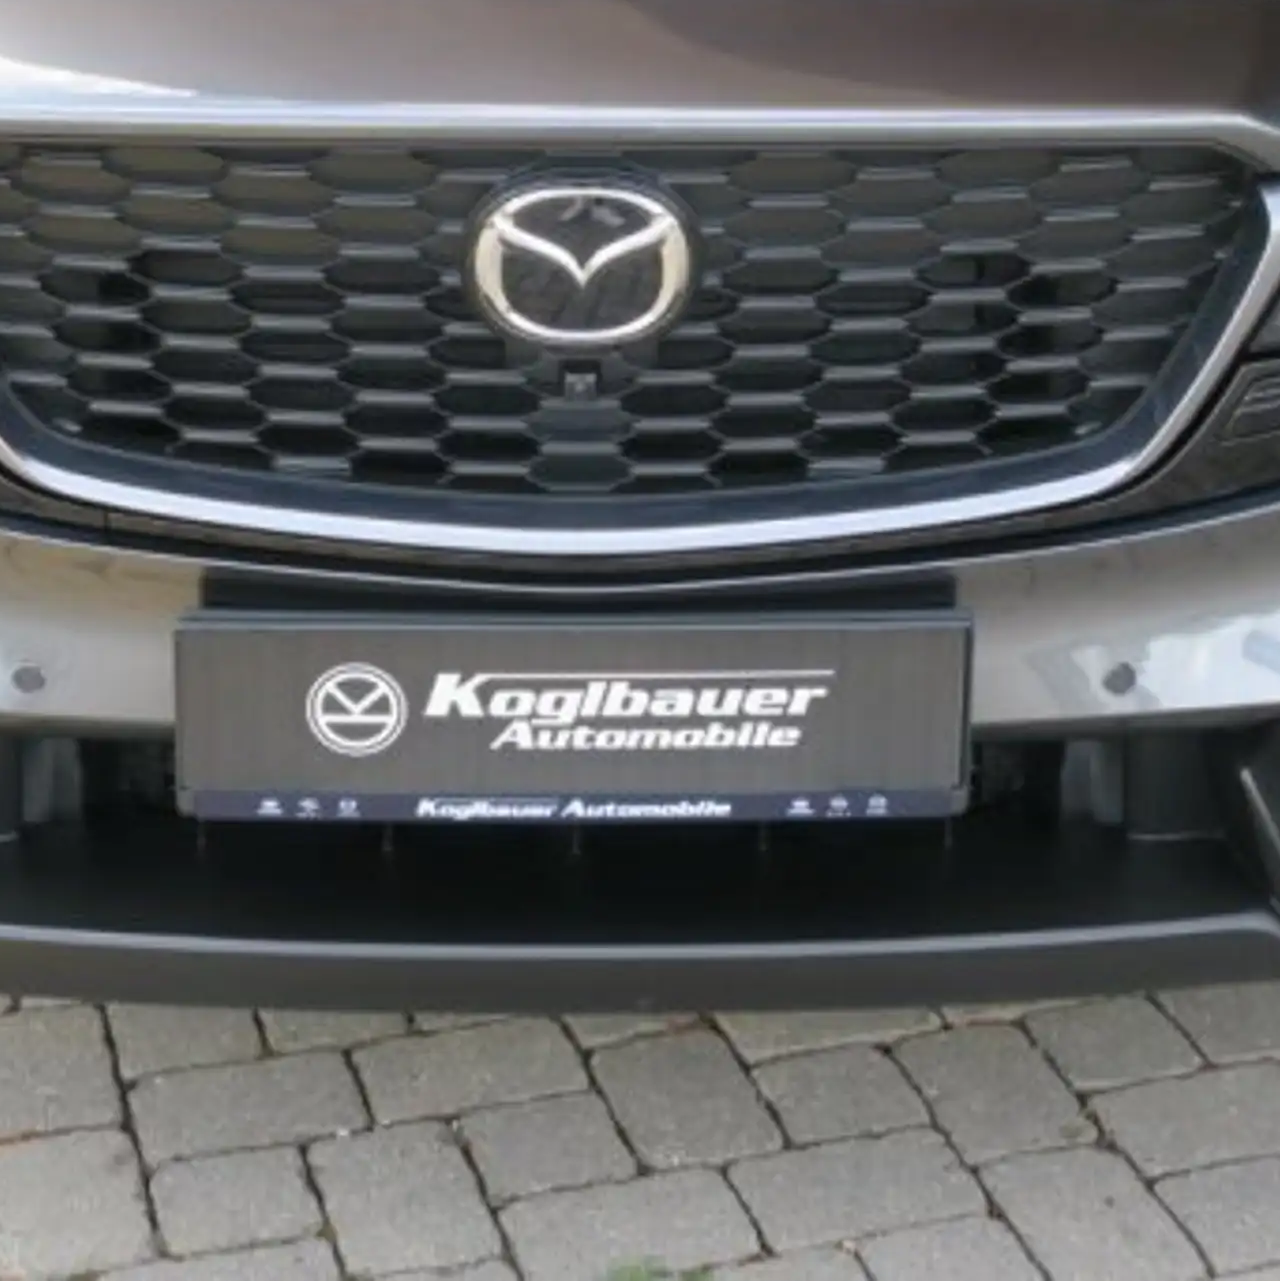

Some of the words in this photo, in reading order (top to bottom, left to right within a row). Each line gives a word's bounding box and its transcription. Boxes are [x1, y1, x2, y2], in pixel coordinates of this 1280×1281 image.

[424, 671, 835, 726] Koglbauer
[489, 721, 802, 751] Automobile
[416, 797, 560, 821] Koglbauer
[561, 798, 732, 818] Automobile
